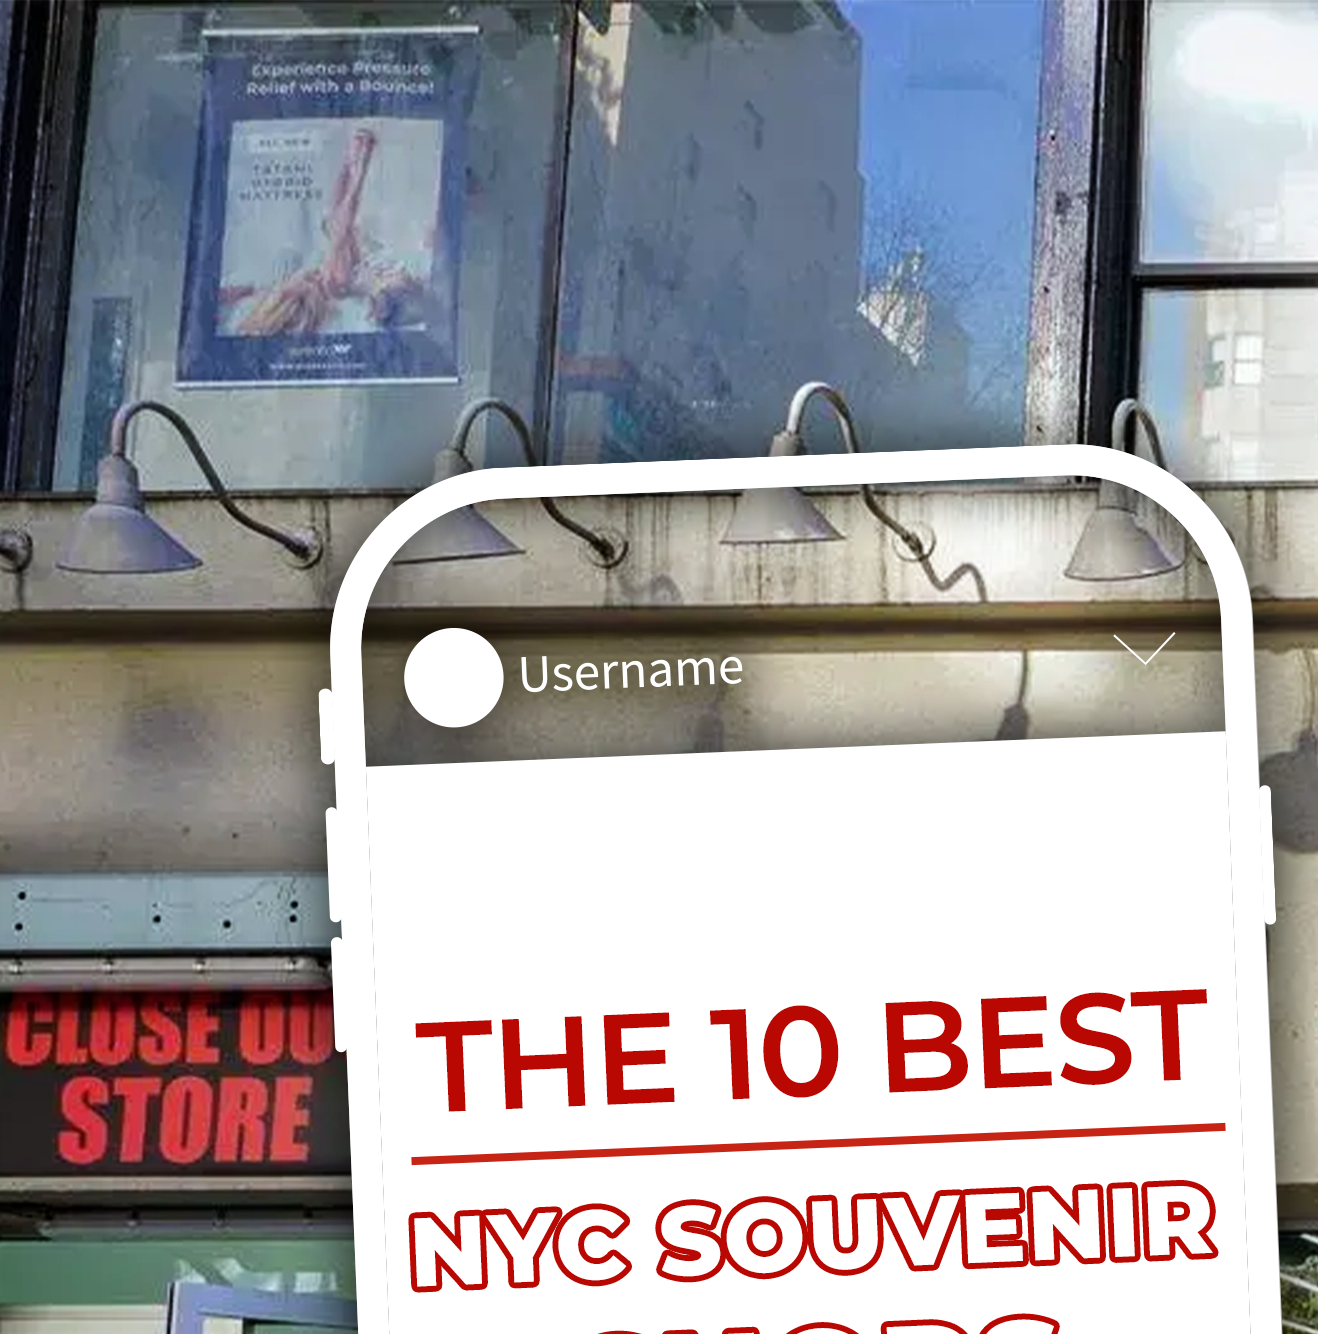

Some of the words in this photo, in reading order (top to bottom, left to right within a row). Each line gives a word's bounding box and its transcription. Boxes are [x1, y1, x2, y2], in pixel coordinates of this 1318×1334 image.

[246, 80, 297, 96] Relief
[299, 79, 339, 94] with
[344, 83, 354, 94] a
[359, 79, 435, 95] Bounce!
[252, 62, 348, 79] Experience
[353, 60, 432, 77] Pressure
[5, 990, 219, 1067] CLOSE
[239, 990, 334, 1066] OU
[57, 1075, 315, 1166] STORE
